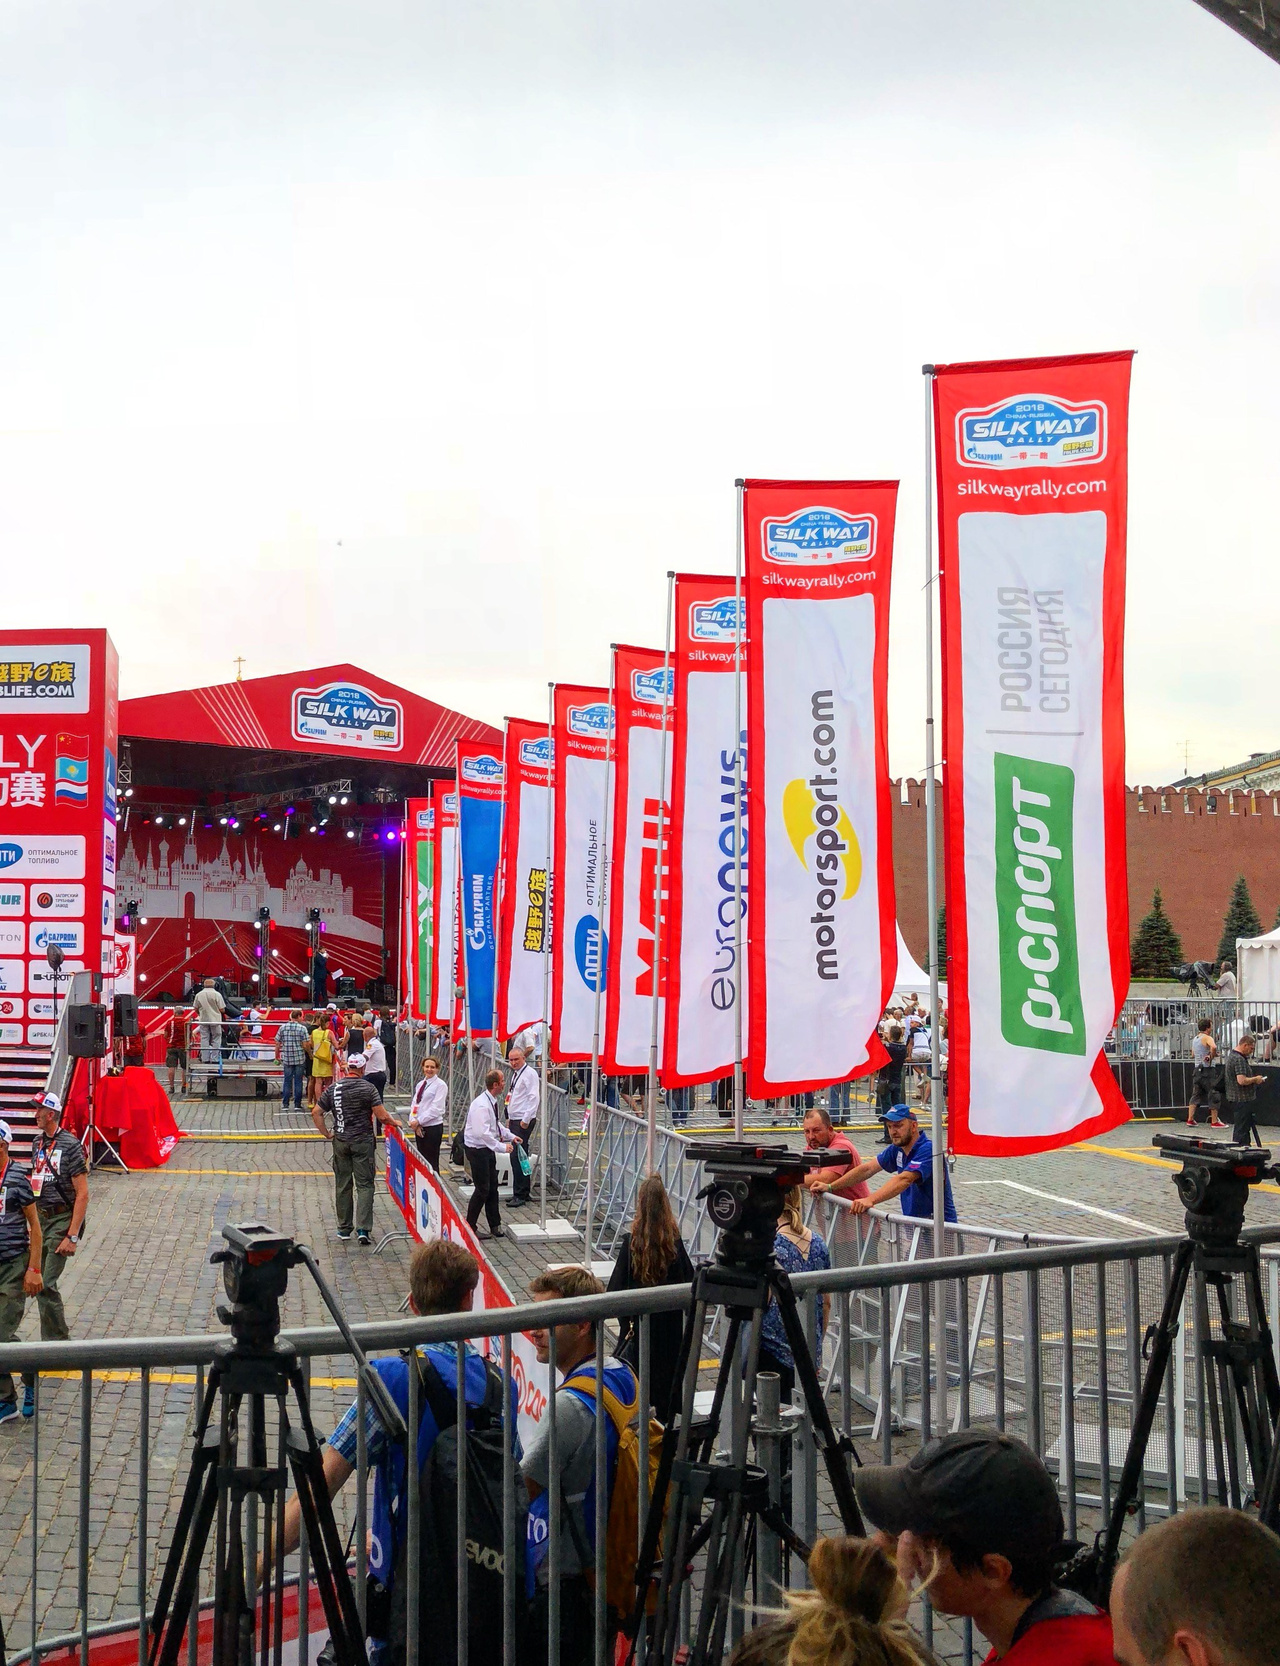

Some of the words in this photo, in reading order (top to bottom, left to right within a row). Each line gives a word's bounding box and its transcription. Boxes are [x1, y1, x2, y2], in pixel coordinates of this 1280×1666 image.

[1015, 403, 1045, 413] 2018
[972, 421, 1034, 438] SILK
[1035, 416, 1090, 435] WAY
[1006, 436, 1054, 444] RALLY
[957, 479, 1107, 502] silkwayrally.com
[774, 528, 821, 540] SILK
[822, 525, 865, 540] WAY
[762, 571, 876, 590] silkwayrally.com
[997, 586, 1032, 713] РОССИЯ
[1039, 589, 1072, 714] СЕГОДНЯ
[338, 691, 360, 699] 2018
[304, 701, 351, 718] SILK
[353, 707, 392, 723] WAY
[575, 713, 601, 724] SILK
[331, 719, 368, 728] RALLY
[526, 745, 549, 755] SILK
[466, 762, 486, 770] SILK
[810, 688, 847, 980] motorsport.com
[586, 819, 597, 906] ОПТИМАЛЬНОЕ
[472, 874, 484, 928] GAZPROM
[485, 875, 493, 911] PARTNER
[48, 933, 77, 941] GAZPROM
[485, 914, 494, 950] GENERAL
[333, 1083, 345, 1133] SECURITY
